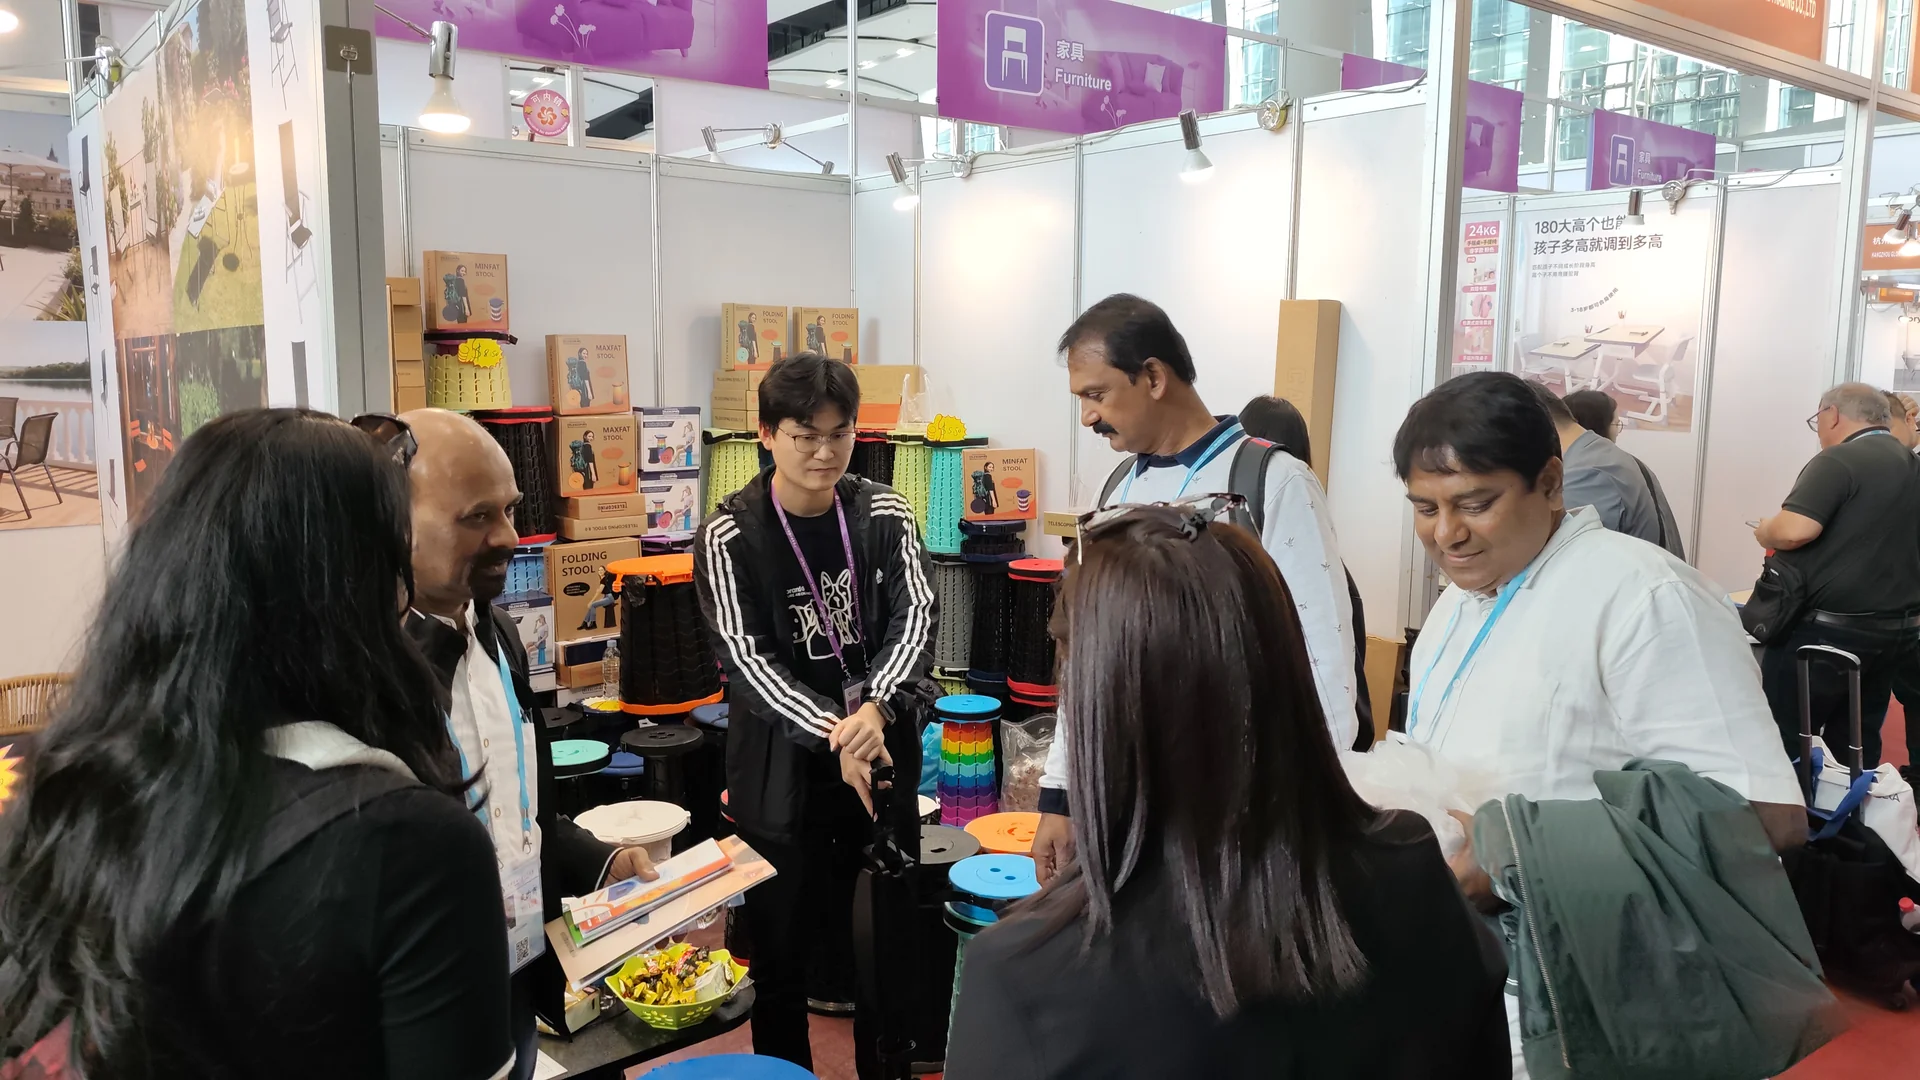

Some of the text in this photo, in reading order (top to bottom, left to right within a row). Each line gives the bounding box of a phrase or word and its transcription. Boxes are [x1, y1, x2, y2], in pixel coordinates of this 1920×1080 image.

[1056, 40, 1084, 62] 家具
[1055, 67, 1112, 91] Furniture
[1639, 151, 1651, 164] 家具
[1637, 169, 1662, 182] Furniture
[1468, 224, 1497, 237] 24KG
[1533, 233, 1664, 256] 孩子多高就调到多高
[474, 262, 500, 271] MINFAT
[762, 310, 784, 318] FOLDING
[595, 344, 622, 352] MAXFAT
[602, 425, 631, 434] MAXFAT
[561, 550, 607, 564] FOLDING
[562, 565, 596, 576] STOOL
